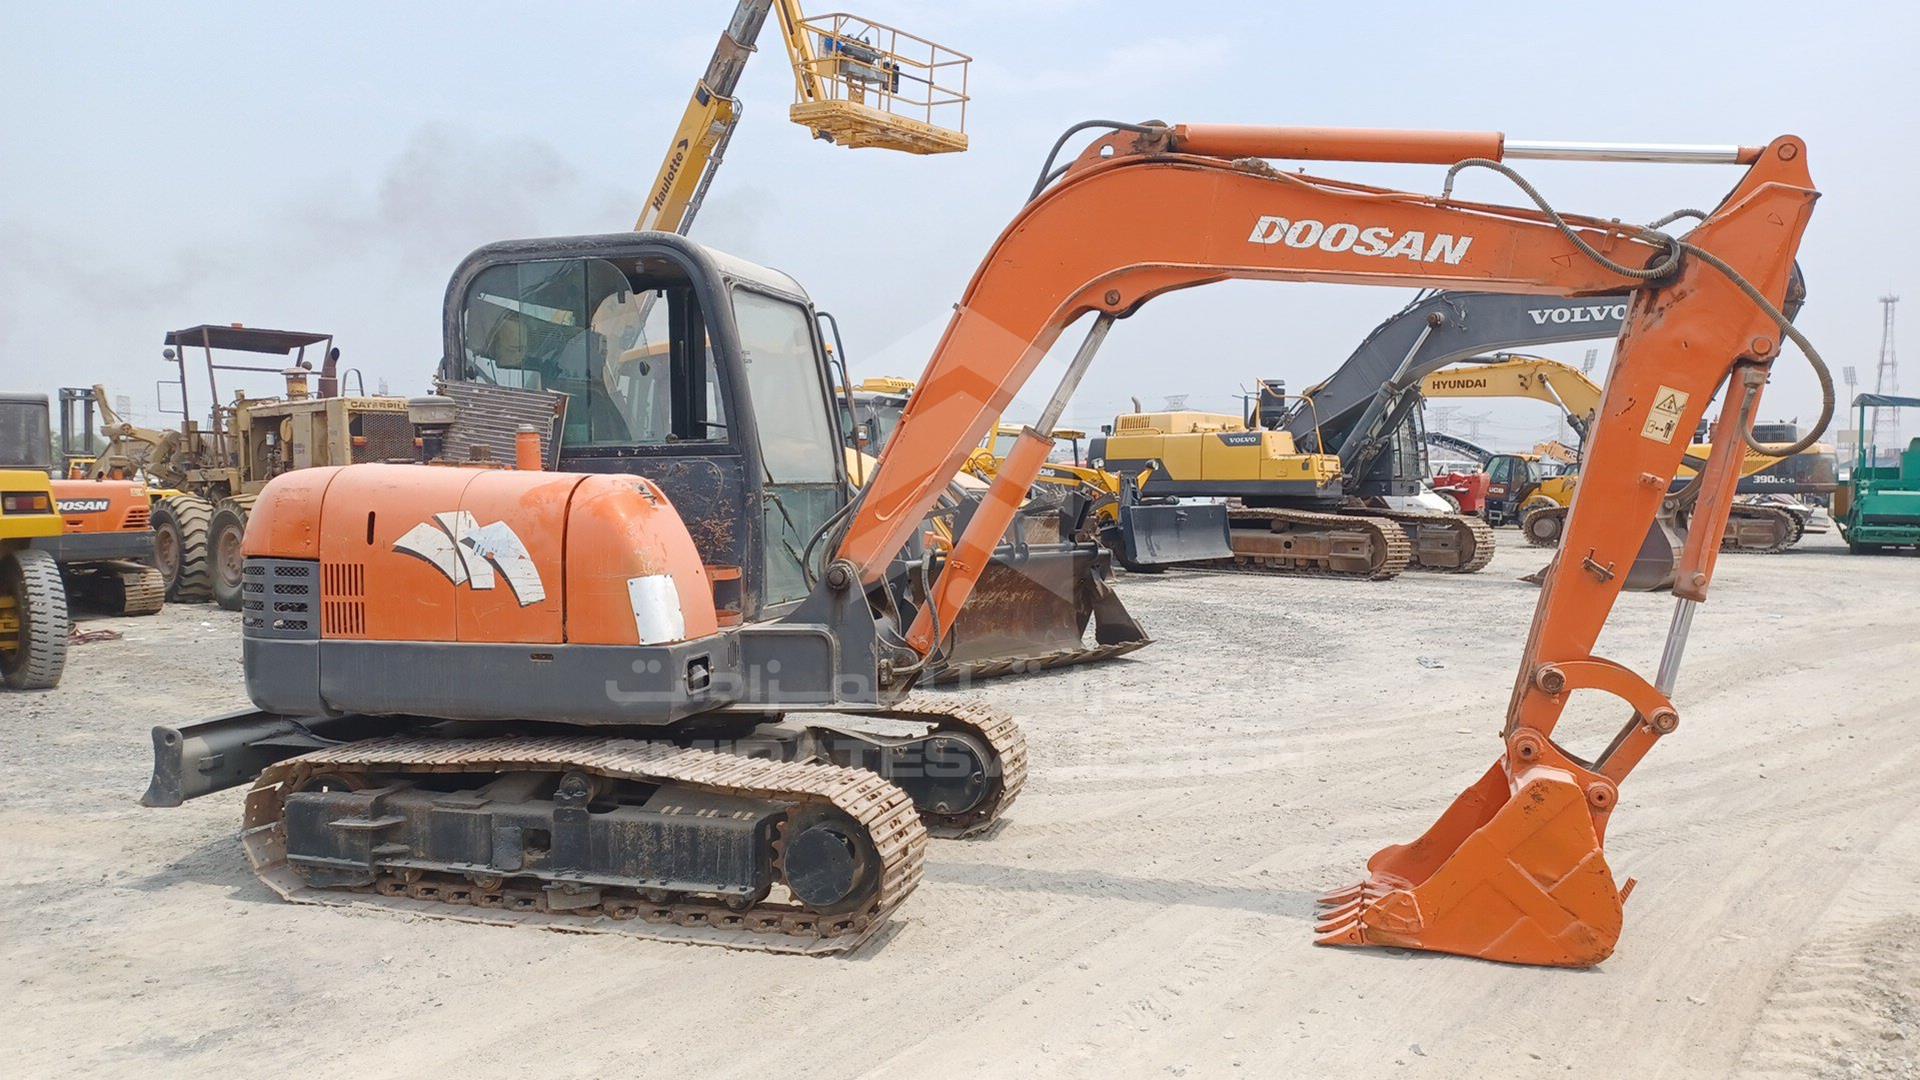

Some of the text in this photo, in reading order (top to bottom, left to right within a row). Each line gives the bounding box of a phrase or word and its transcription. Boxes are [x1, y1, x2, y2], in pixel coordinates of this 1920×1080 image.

[653, 151, 684, 211] Haulotte
[1248, 215, 1473, 265] DOOSAN
[1527, 304, 1628, 325] VOLVO
[1432, 379, 1487, 390] HYUNDAI
